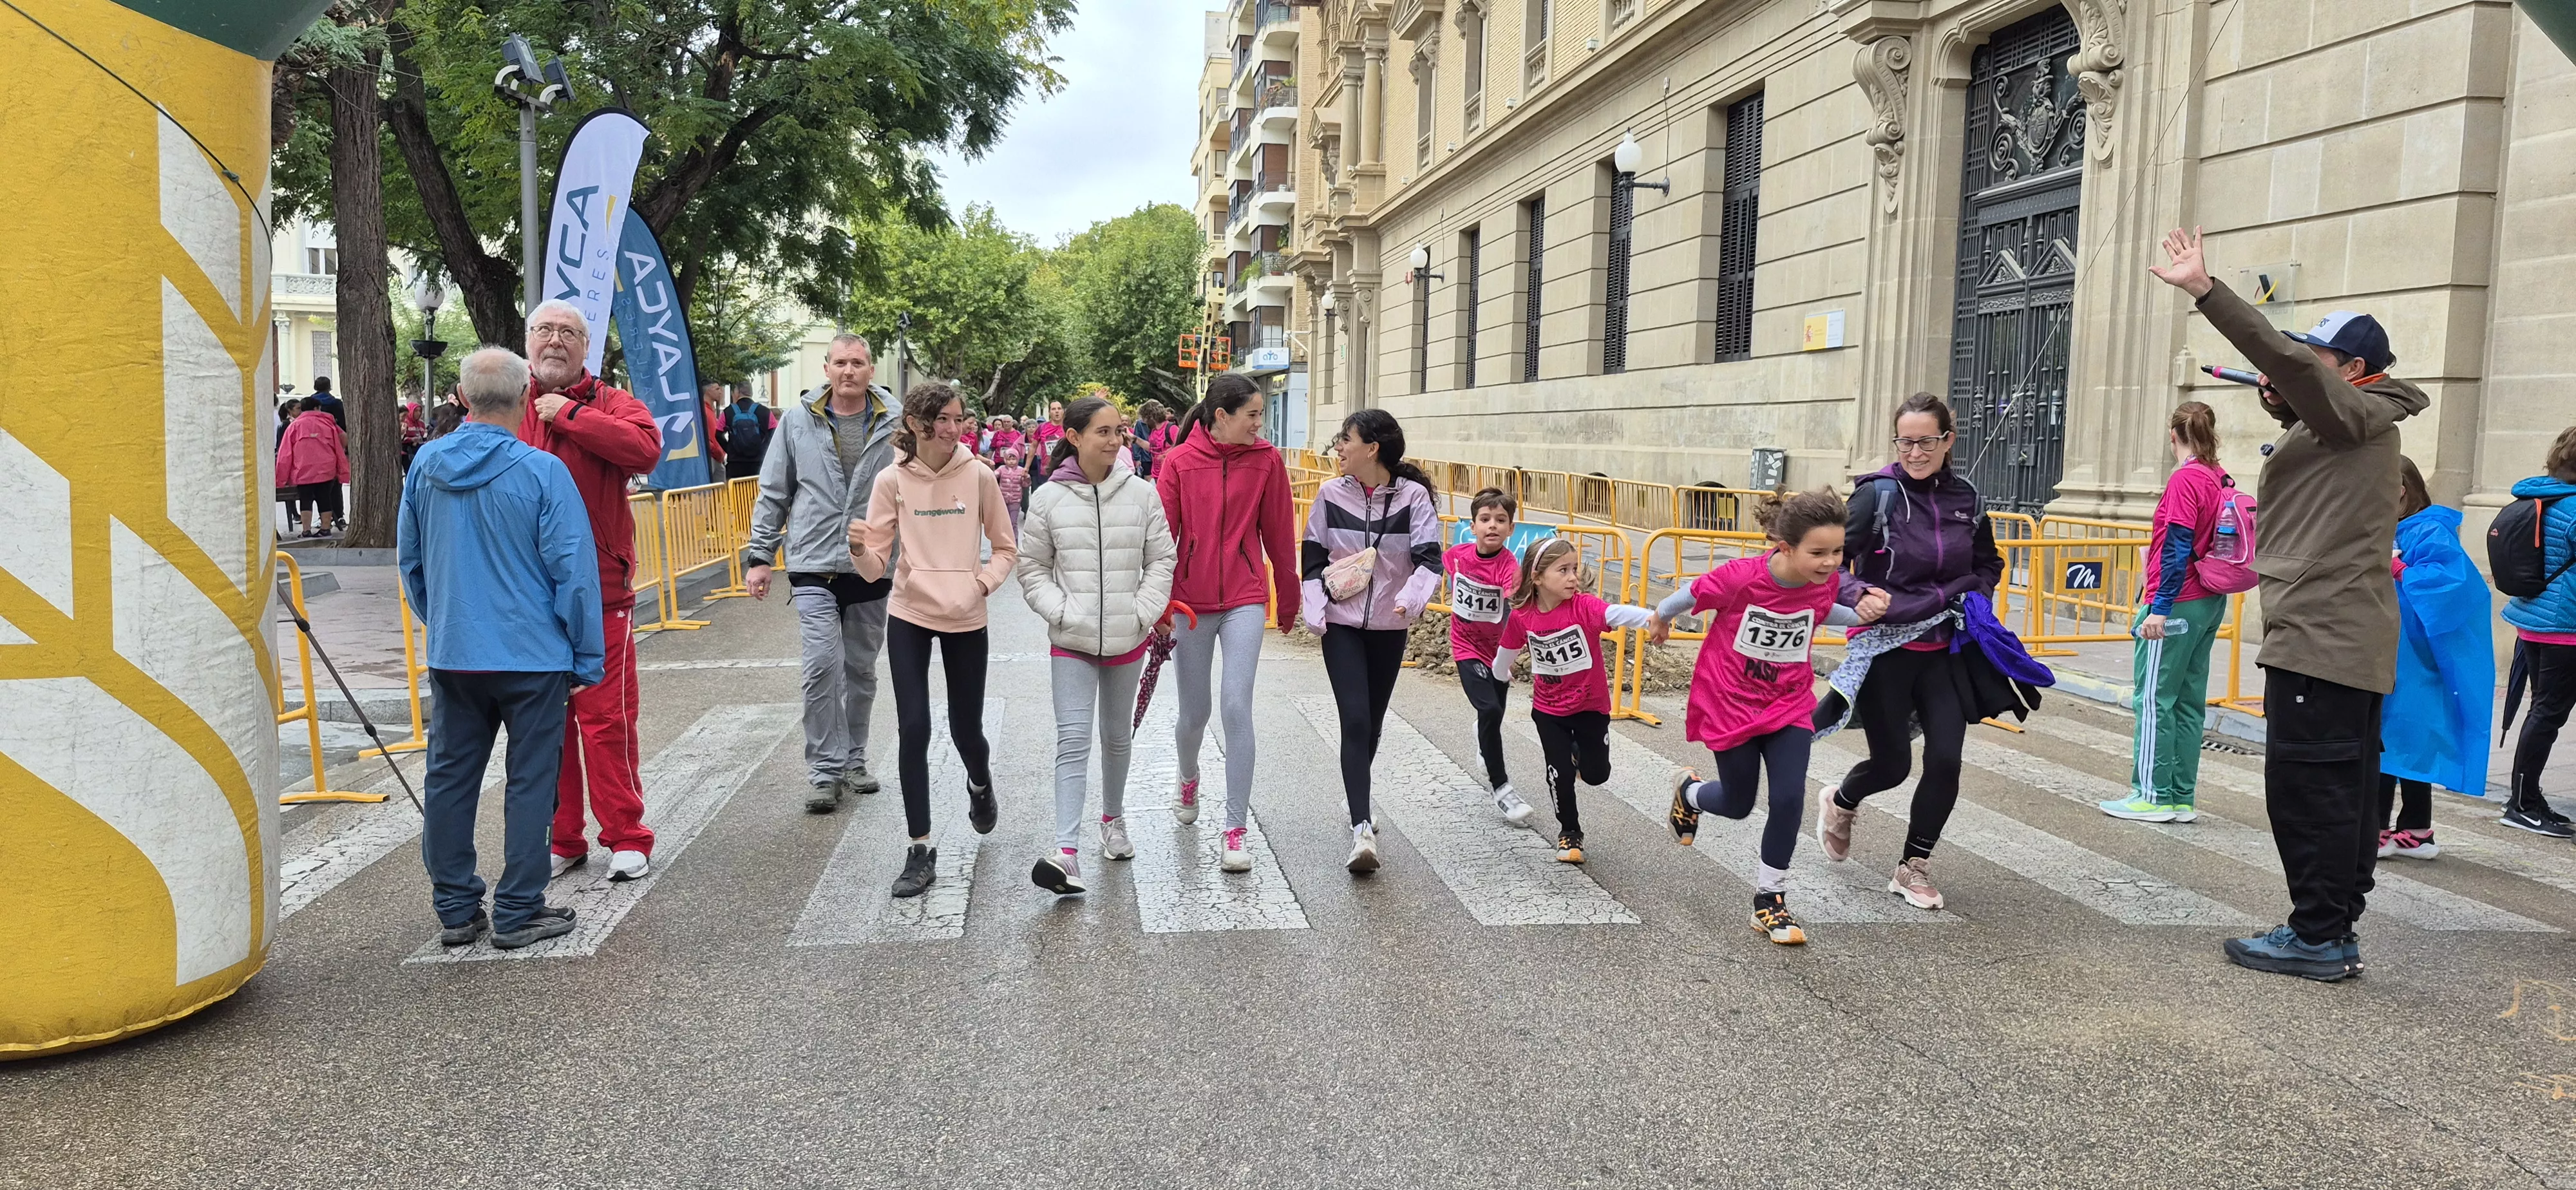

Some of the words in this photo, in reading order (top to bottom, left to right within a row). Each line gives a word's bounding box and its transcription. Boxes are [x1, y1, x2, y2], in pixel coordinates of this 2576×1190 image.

[554, 185, 600, 301] YCA
[1456, 589, 1498, 612] 3414
[1748, 626, 1805, 648] 1376
[1533, 641, 1582, 665] 3415
